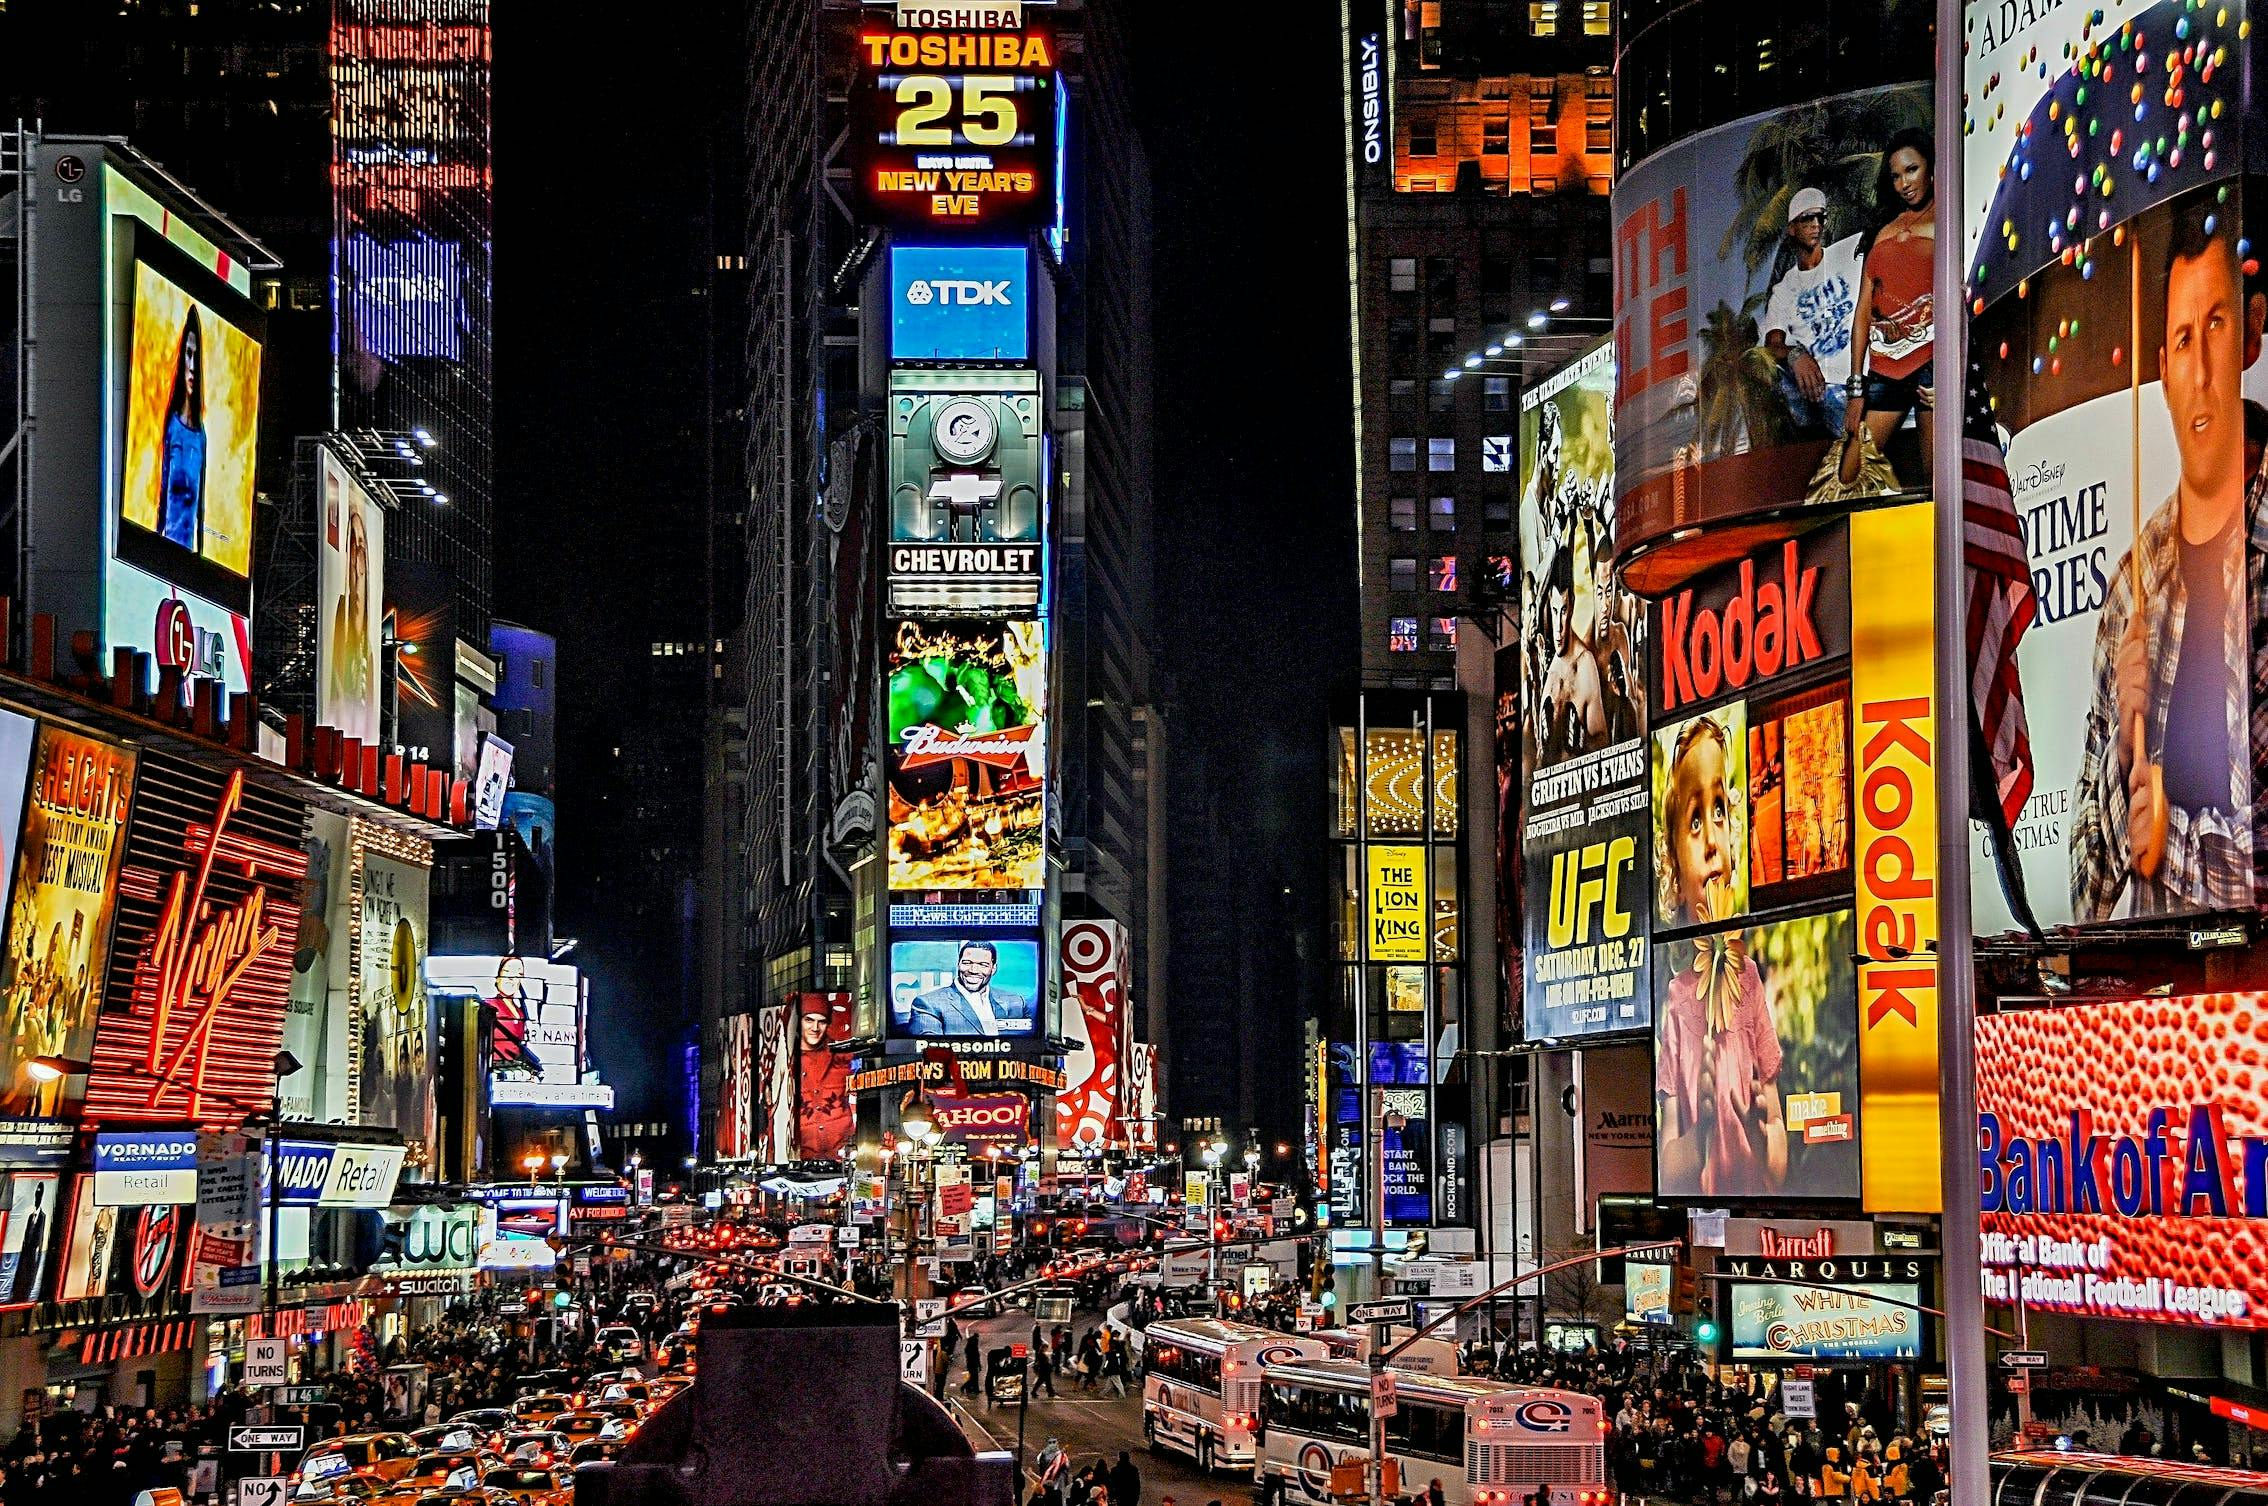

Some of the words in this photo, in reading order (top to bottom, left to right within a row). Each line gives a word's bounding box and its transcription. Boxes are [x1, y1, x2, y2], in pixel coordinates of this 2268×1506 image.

[902, 9, 1018, 28] TOSHIBA
[862, 36, 1051, 67] TOSHIBA
[895, 75, 1018, 146] 25
[878, 171, 940, 192] NEW
[945, 171, 1034, 192] YEAR'S
[57, 188, 83, 203] LG
[931, 194, 980, 215] EVE
[931, 280, 1012, 305] TDK
[1521, 386, 1539, 413] THE
[2016, 480, 2109, 559] TIME
[894, 549, 1034, 573] CHEVROLET
[2031, 546, 2108, 629] RIES
[1662, 539, 1823, 711] Kodak
[899, 725, 1030, 757] Budweiser
[46, 742, 129, 826] HEIGHTS
[1531, 768, 1582, 807] GRIFFIN
[1582, 763, 1600, 791] VS
[1601, 748, 1645, 787] EVANS
[2030, 789, 2069, 819] TRUE
[1569, 809, 1585, 829] MIR
[1982, 821, 2060, 858] CSTMAS
[64, 848, 105, 894] MUSICAL
[491, 832, 507, 909] 1500
[1381, 867, 1413, 883] THE
[1861, 696, 1937, 1031] Kodak
[1375, 888, 1418, 915] LION
[1547, 835, 1635, 949] UFC
[1375, 917, 1420, 945] KING
[153, 769, 279, 1119] Virgin
[1535, 945, 1598, 984] SATURDAY,
[1598, 940, 1628, 973] DEC.
[1628, 936, 1645, 968] 27
[1411, 1096, 1425, 1114] 2
[1789, 1090, 1827, 1122] make
[1588, 1132, 1610, 1140] NEW
[1611, 1132, 1636, 1140] YORK
[1808, 1120, 1848, 1139] something
[97, 1142, 197, 1157] VORNADO
[1384, 1150, 1415, 1159] START
[1978, 1108, 2102, 1216] Bank
[2111, 1105, 2170, 1218] of
[336, 1157, 390, 1193] Retail
[1389, 1161, 1420, 1171] BAND.
[1407, 1173, 1425, 1183] THE
[1447, 1128, 1456, 1218] ROCKBAND.COM
[124, 1175, 169, 1189] Retail
[2038, 1235, 2086, 1268] Bank
[1731, 1261, 1920, 1278] MARQUIS
[400, 1275, 460, 1295] swatch
[1407, 1282, 1418, 1294] 46
[918, 1302, 940, 1310] NYPD
[1793, 1289, 1872, 1313] WHITE
[2084, 1274, 2164, 1311] Football
[2164, 1278, 2248, 1323] League
[1355, 1306, 1374, 1318] ONE
[1382, 1304, 1404, 1317] WAY
[250, 1309, 296, 1338] PLNET
[1766, 1311, 1908, 1352] CHRISTMAS
[256, 1346, 275, 1360] NO
[2005, 1355, 2021, 1364] ONE
[2026, 1355, 2042, 1364] WAY
[247, 1365, 284, 1377] TURNS
[902, 1370, 923, 1379] URN
[289, 1389, 298, 1402] W
[300, 1389, 312, 1402] 46
[1378, 1379, 1390, 1392] NO
[1375, 1394, 1395, 1409] TURNS
[240, 1433, 262, 1444] ONE
[270, 1432, 293, 1444] WAY
[244, 1482, 266, 1496] NO
